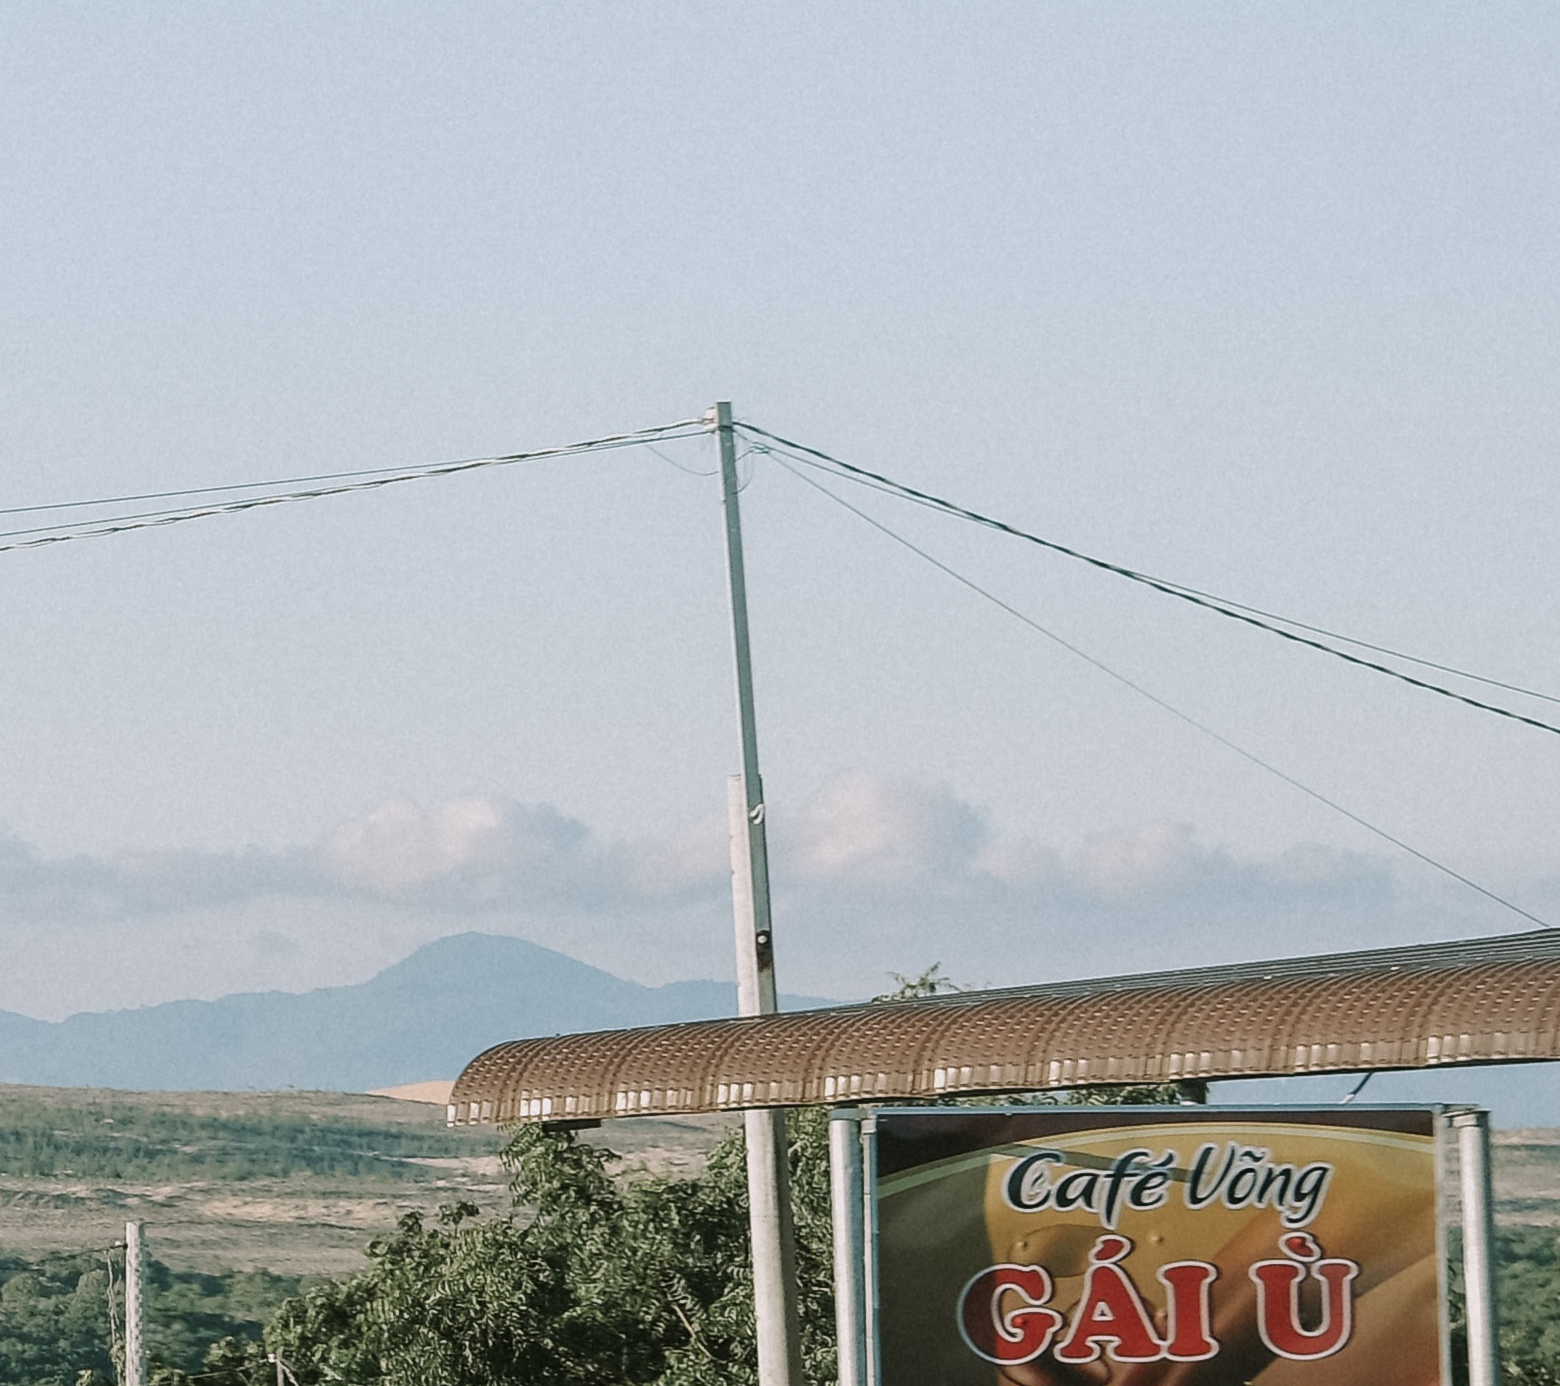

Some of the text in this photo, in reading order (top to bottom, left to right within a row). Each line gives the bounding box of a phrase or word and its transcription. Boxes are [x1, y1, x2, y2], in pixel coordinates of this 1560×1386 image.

[1002, 1142, 1334, 1229] Café Võng
[957, 1232, 1360, 1364] GÁI Ù
